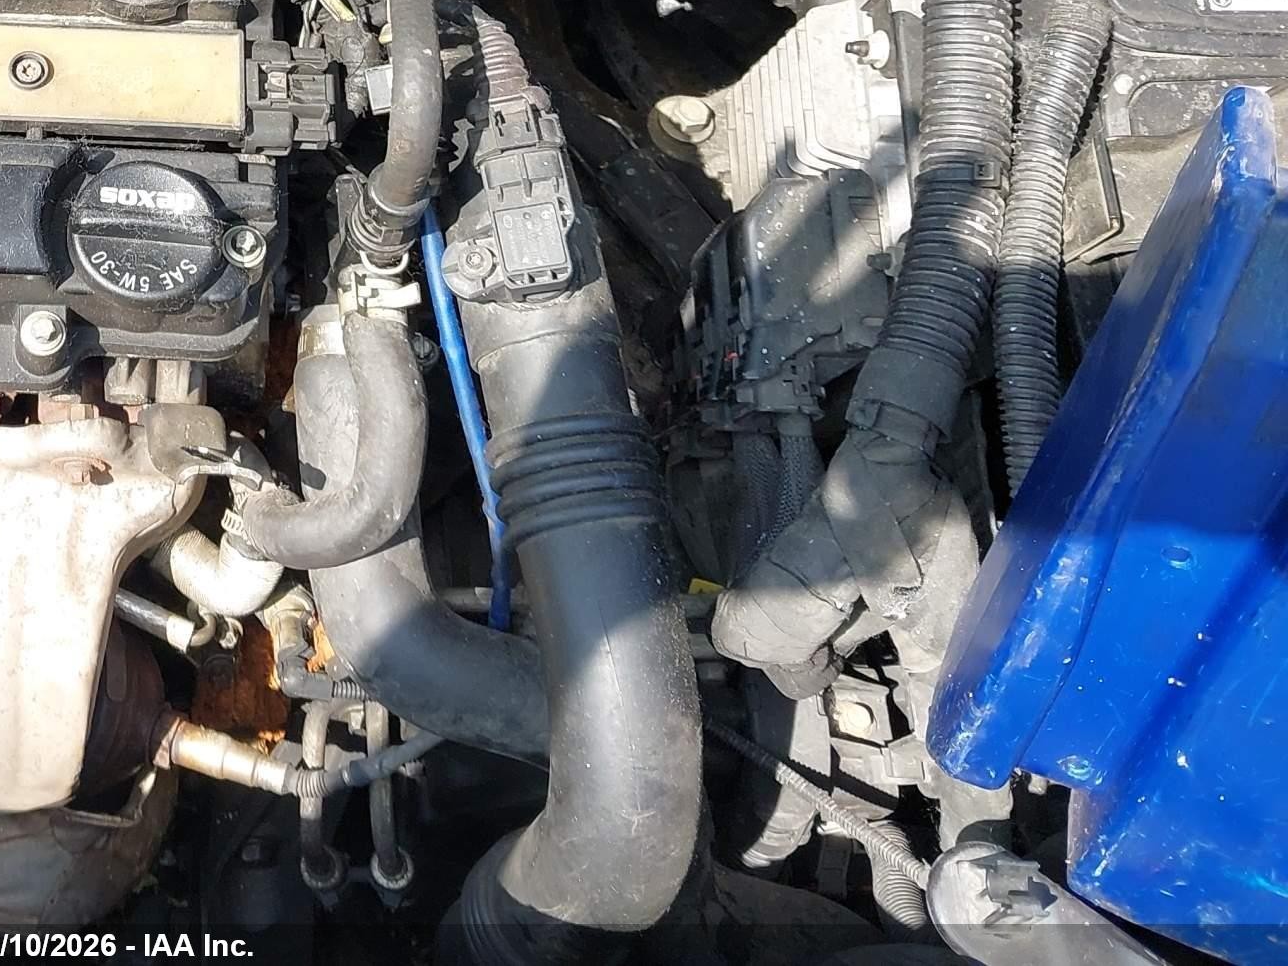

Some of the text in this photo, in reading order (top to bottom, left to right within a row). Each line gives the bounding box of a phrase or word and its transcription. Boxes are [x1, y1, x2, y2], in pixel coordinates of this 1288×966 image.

[99, 185, 196, 215] dexos
[90, 250, 198, 293] SAE 5W-30
